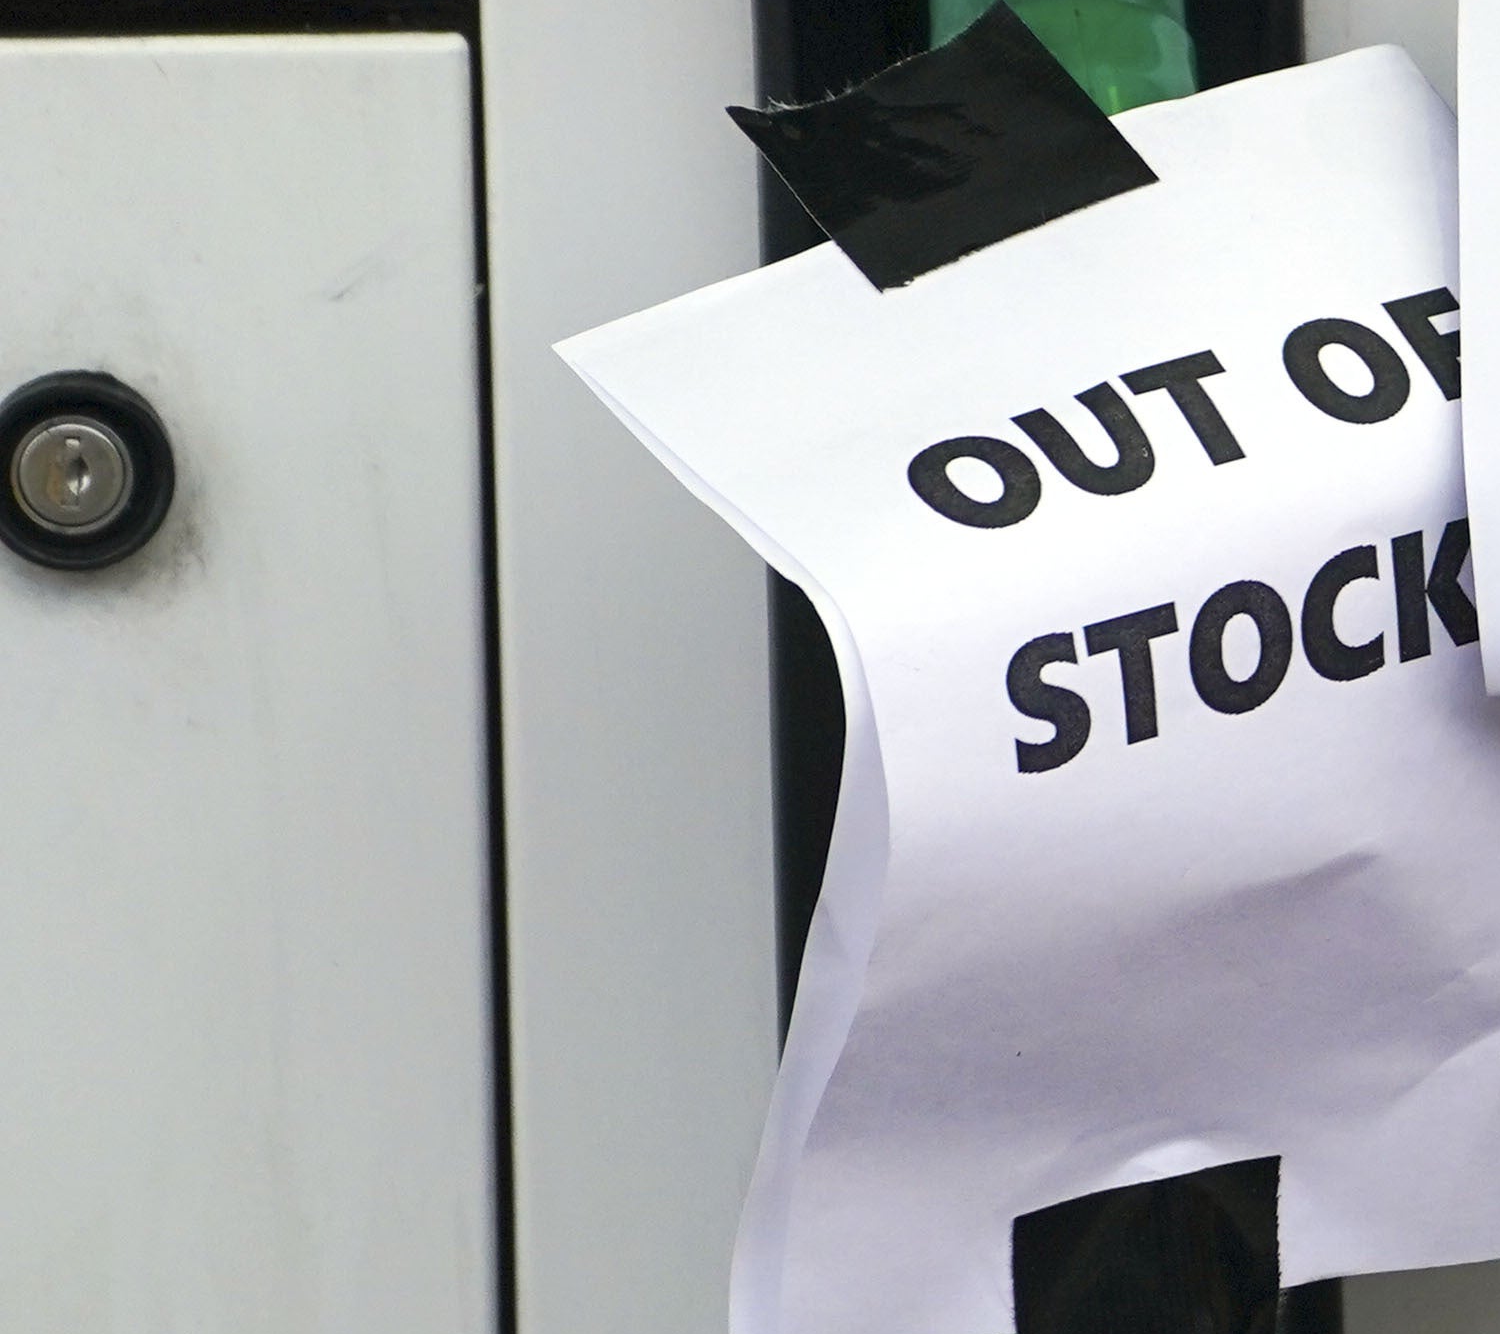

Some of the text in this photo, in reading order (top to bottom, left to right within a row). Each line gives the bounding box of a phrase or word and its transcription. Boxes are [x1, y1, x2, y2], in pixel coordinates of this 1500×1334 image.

[907, 286, 1462, 529] OUT OF
[1006, 509, 1481, 774] STOCK
